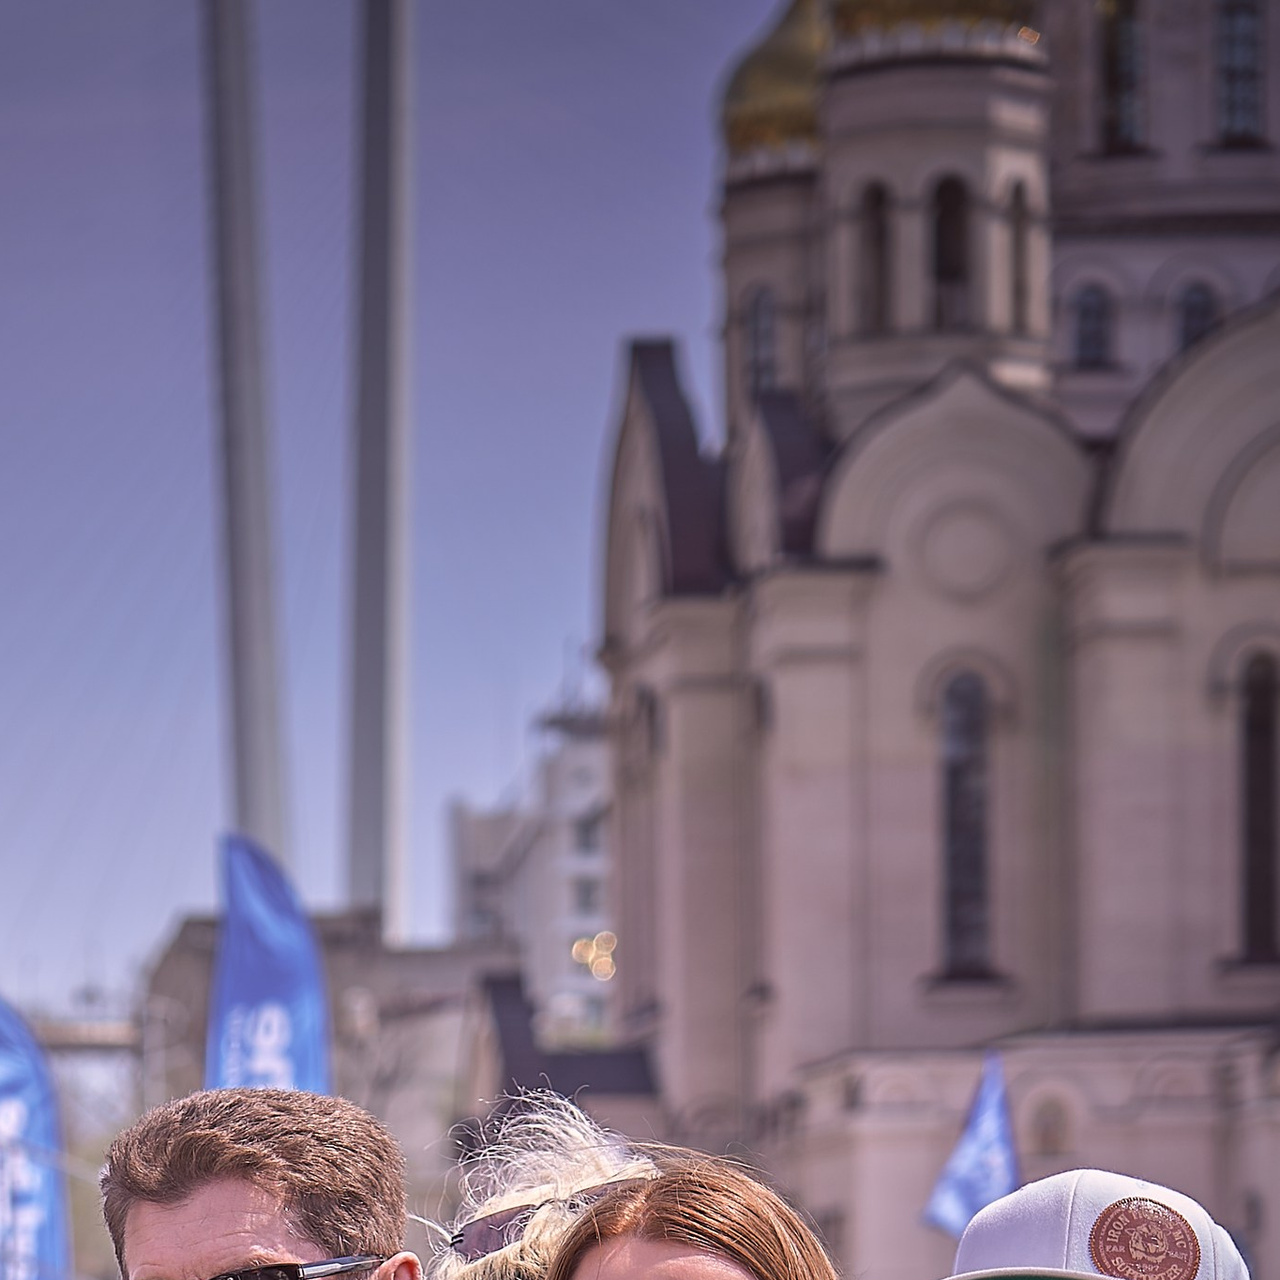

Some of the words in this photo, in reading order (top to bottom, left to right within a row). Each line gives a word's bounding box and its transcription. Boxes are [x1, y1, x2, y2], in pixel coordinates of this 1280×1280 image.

[1106, 1213, 1130, 1243] IRON
[1172, 1229, 1187, 1249] MC
[1105, 1245, 1126, 1253] FAR
